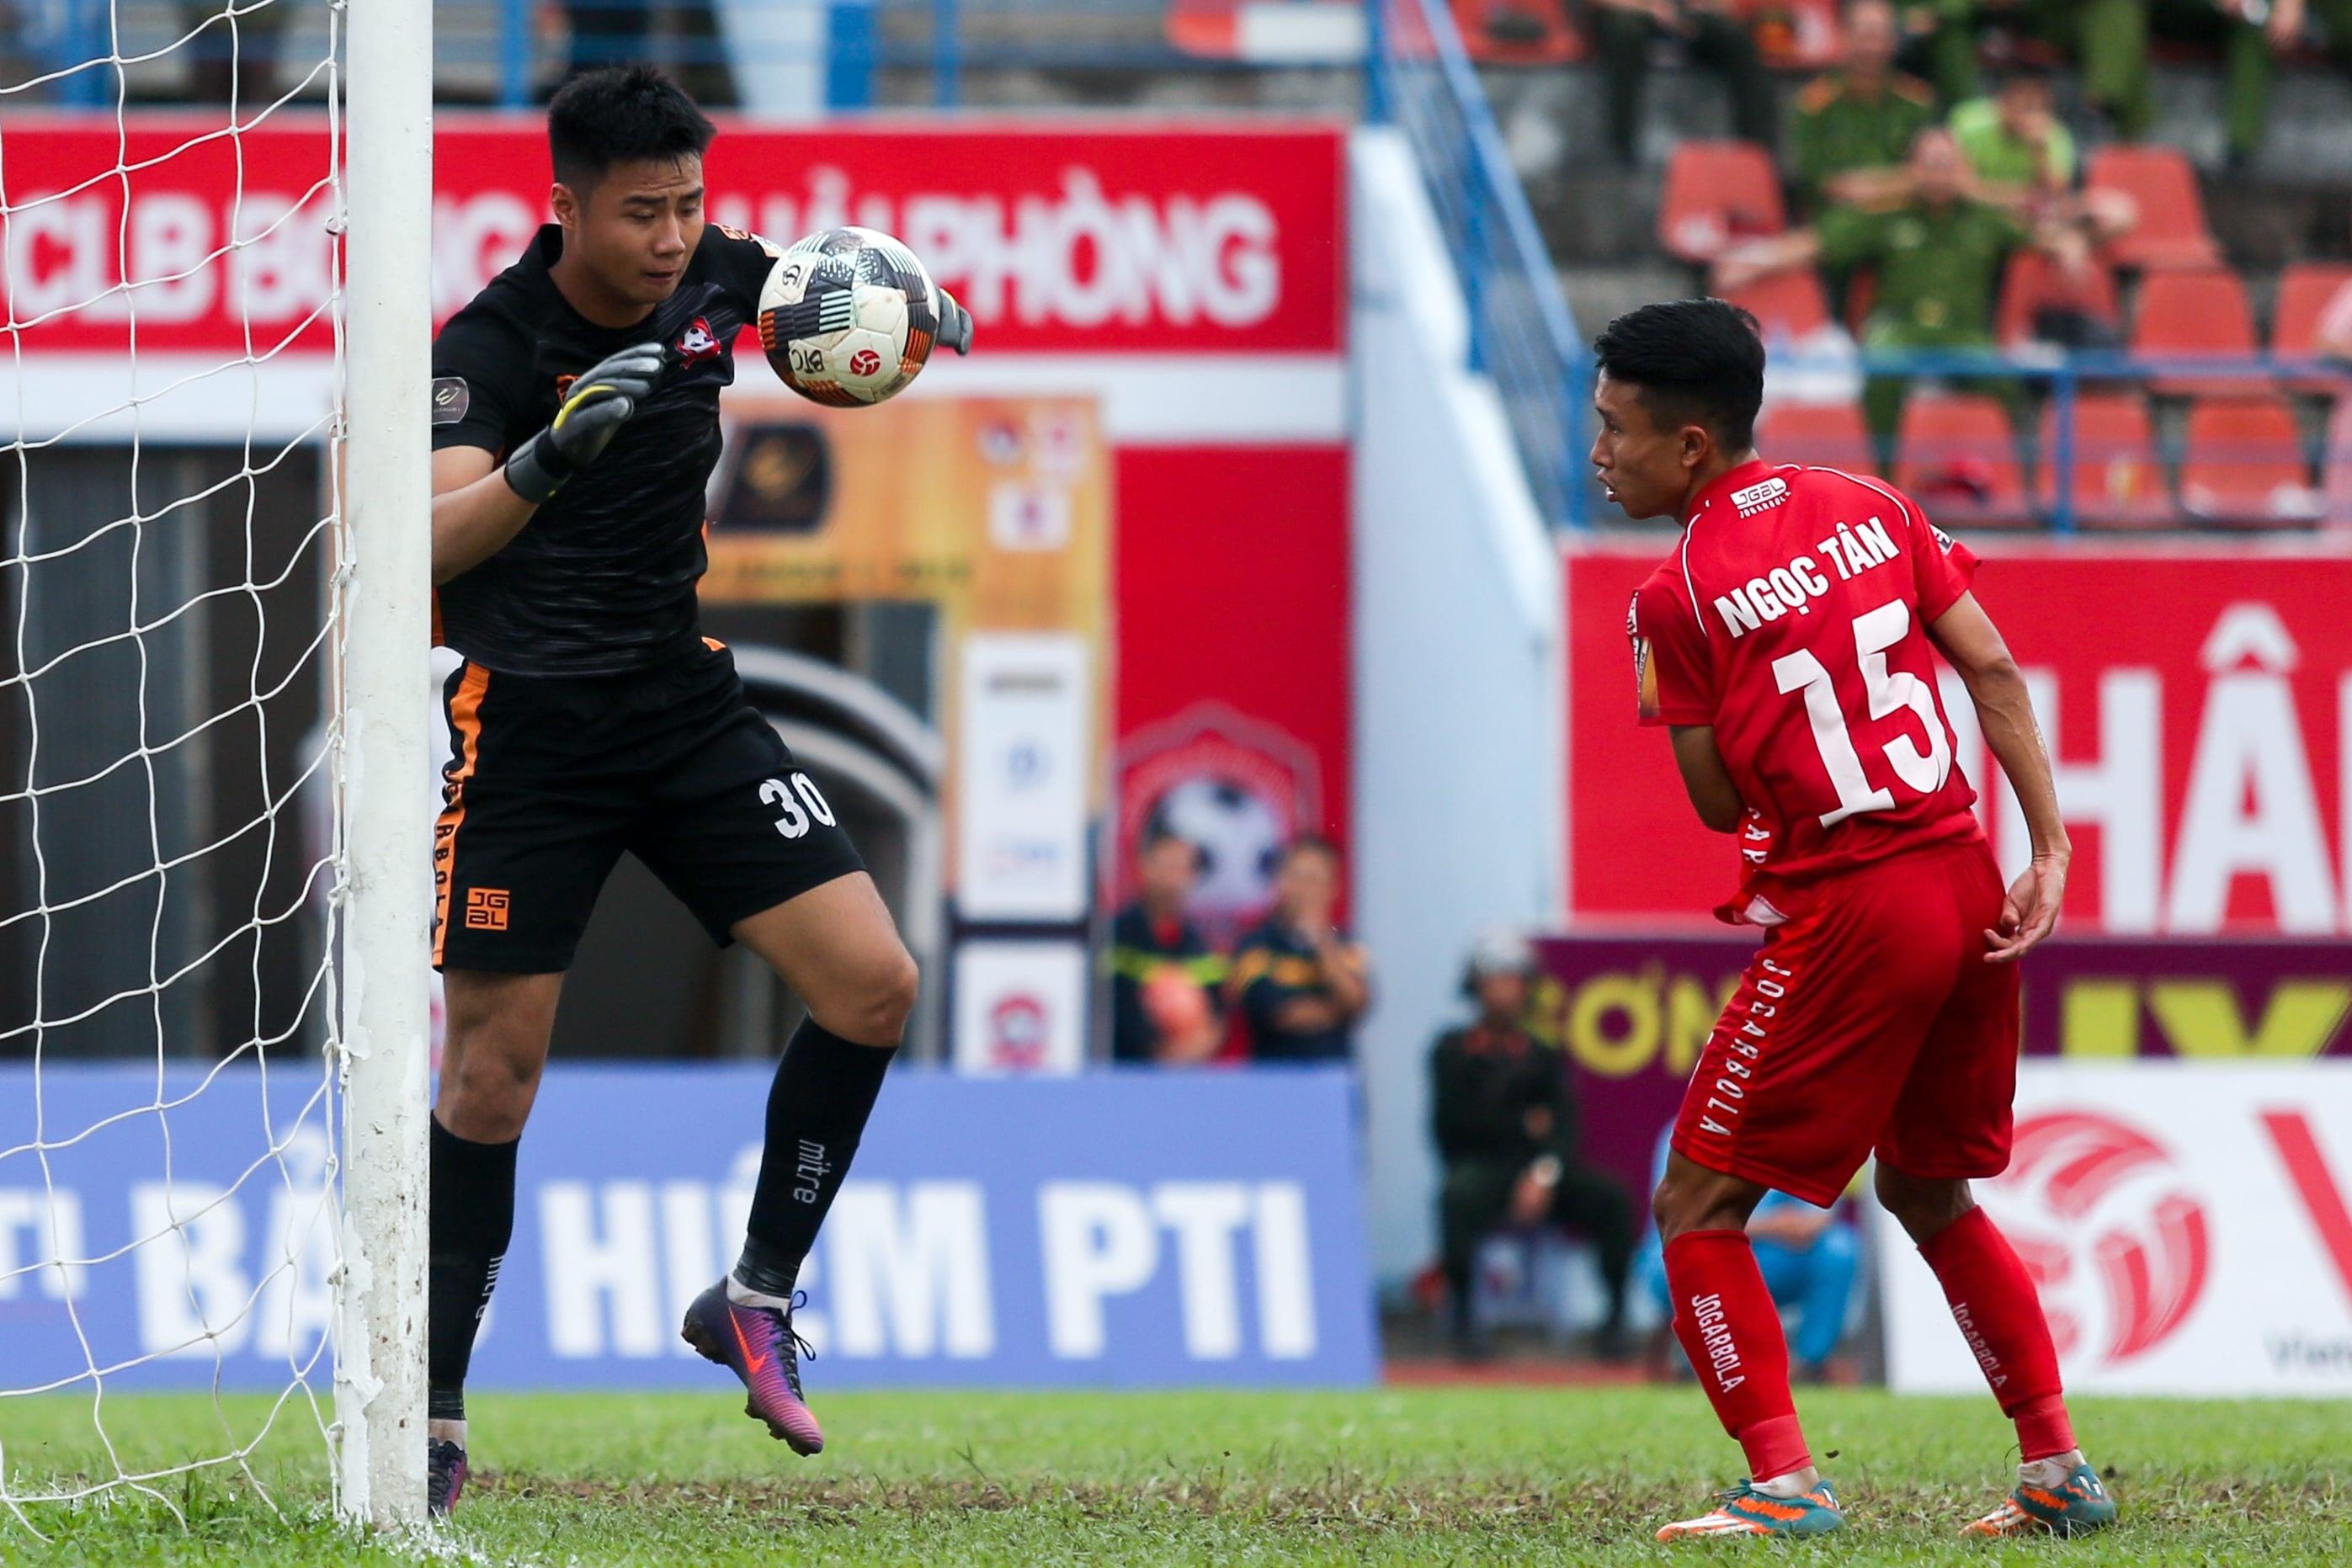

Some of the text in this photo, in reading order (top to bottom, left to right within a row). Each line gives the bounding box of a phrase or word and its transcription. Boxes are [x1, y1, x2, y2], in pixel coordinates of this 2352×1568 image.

[7, 190, 217, 326] CLB
[904, 166, 1279, 327] PHÒNG
[790, 349, 824, 374] BTC
[1737, 481, 1784, 506] JGBL
[1714, 555, 1830, 639] NGỌC
[1817, 516, 1900, 581] TÂN
[1771, 598, 1953, 828] 15
[758, 771, 836, 839] 30
[1700, 959, 1792, 1136] JOGARBOLA
[793, 1138, 832, 1204] mitre
[1036, 1182, 1317, 1359] PTI
[1691, 1293, 1746, 1394] JOGARBOLA
